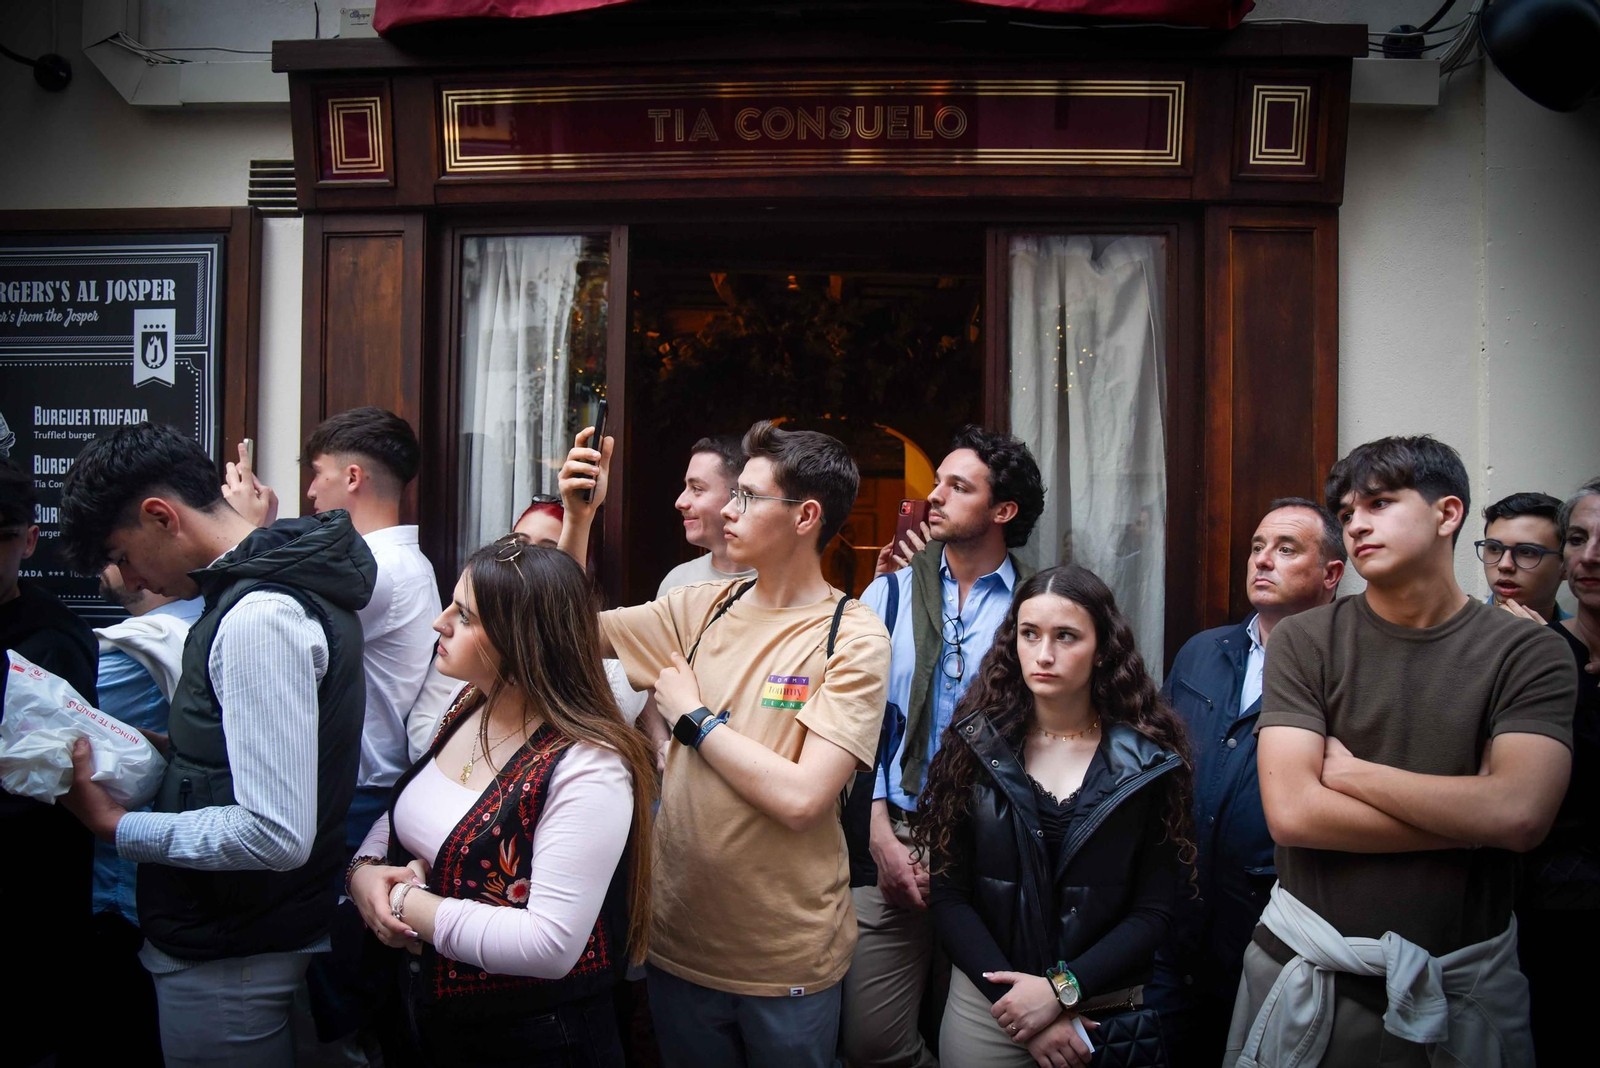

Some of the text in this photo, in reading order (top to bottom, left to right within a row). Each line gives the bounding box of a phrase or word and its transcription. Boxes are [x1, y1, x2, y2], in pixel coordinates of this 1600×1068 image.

[647, 105, 968, 143] TIA CONSUELO
[76, 280, 100, 302] AL
[105, 278, 176, 305] JOSPER
[16, 308, 45, 328] from
[44, 307, 64, 323] the
[63, 308, 100, 328] Josper
[93, 408, 149, 426] TRUFADA
[33, 430, 96, 442] Truffled burger
[97, 716, 109, 728] TE
[110, 723, 140, 745] NUNCA
